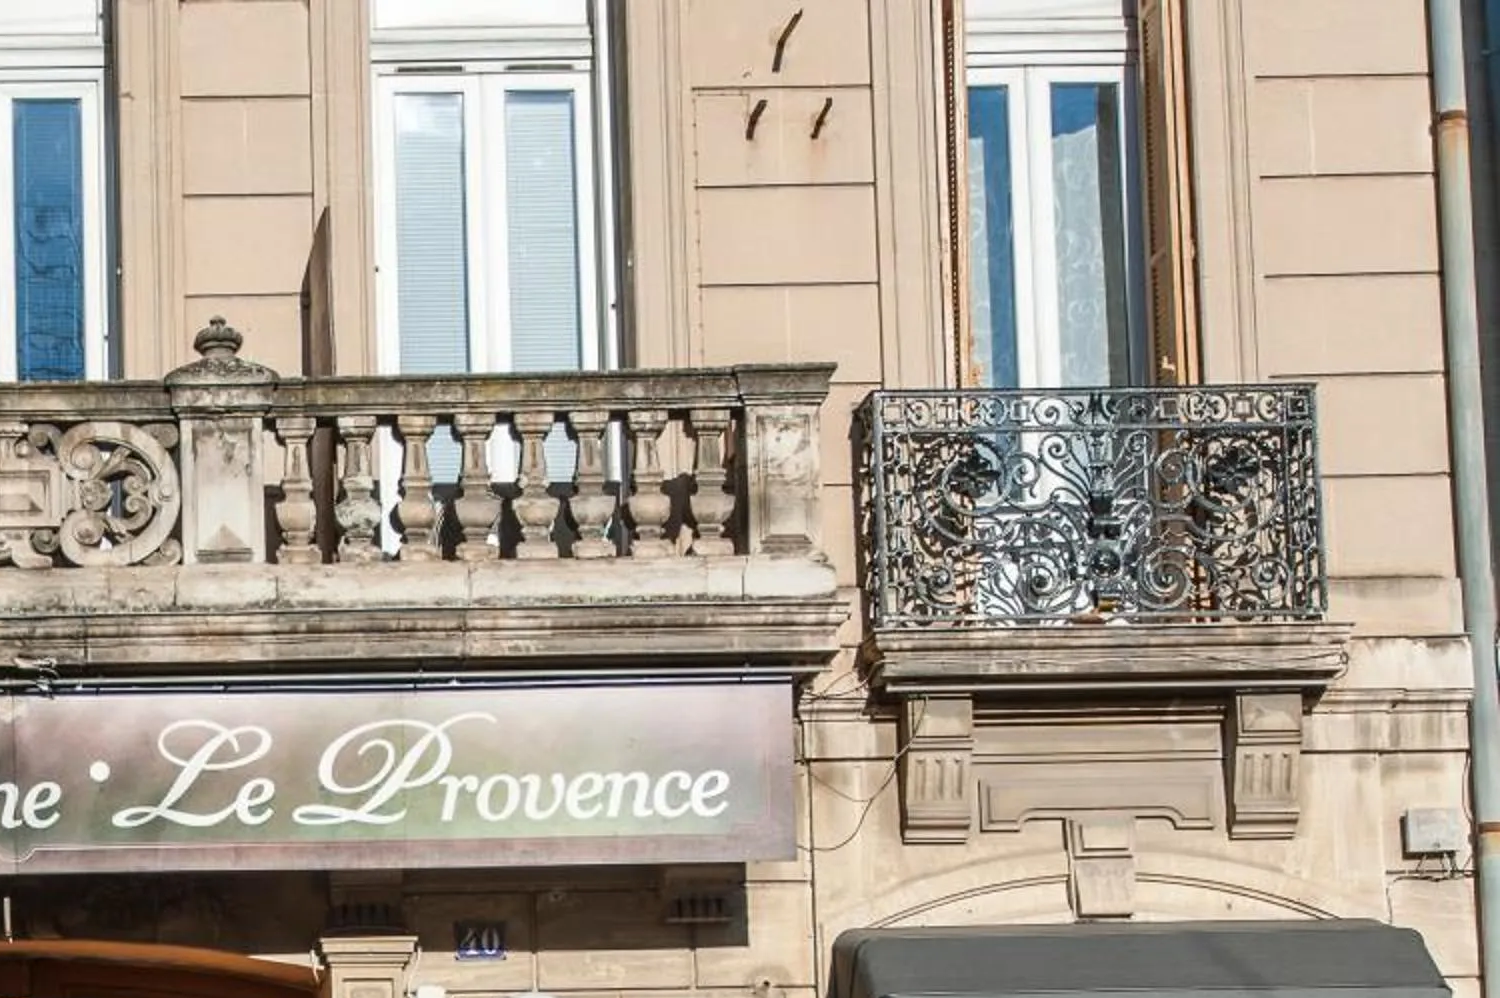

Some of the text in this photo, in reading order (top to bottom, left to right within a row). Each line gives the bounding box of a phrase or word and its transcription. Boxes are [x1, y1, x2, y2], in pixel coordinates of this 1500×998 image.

[112, 719, 276, 829] Le
[293, 711, 731, 825] Provence
[460, 927, 500, 955] 40
